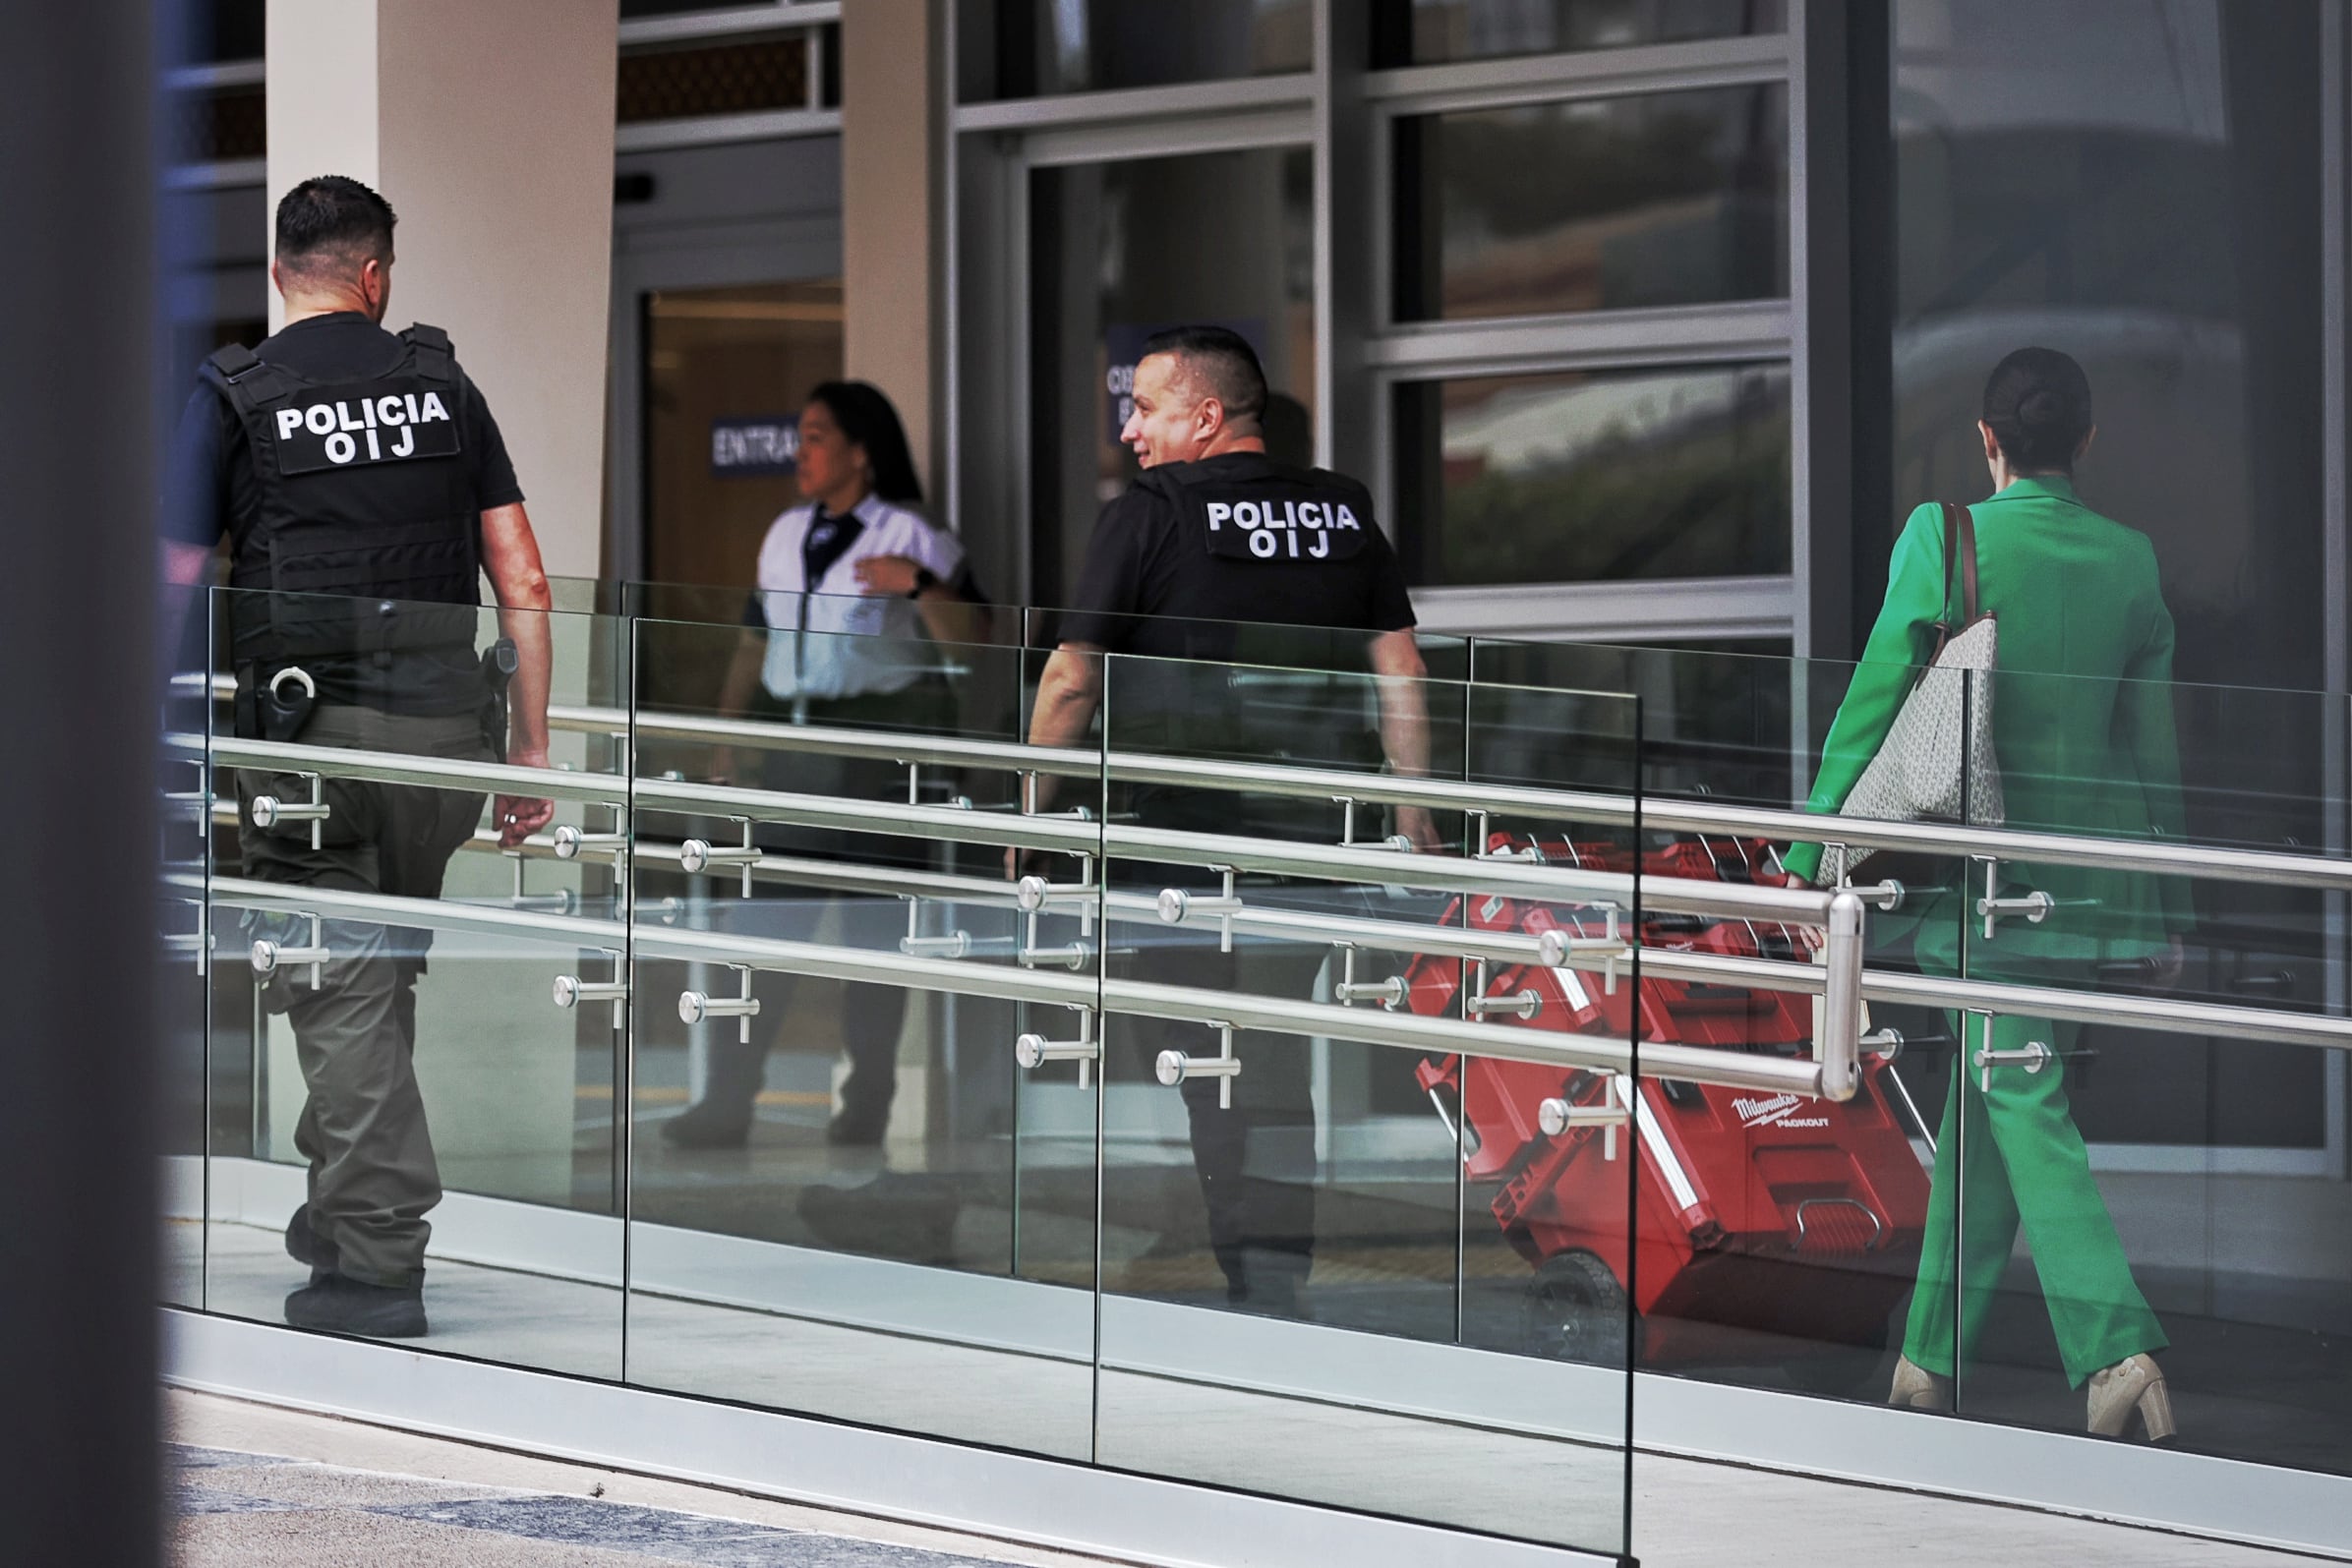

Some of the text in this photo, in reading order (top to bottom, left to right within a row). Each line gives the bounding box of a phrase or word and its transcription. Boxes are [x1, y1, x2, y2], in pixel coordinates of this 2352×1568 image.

[275, 392, 450, 440] POLICIA
[324, 425, 415, 464] OIJ
[1206, 500, 1361, 531] POLICIA
[1249, 529, 1329, 558] OIJ
[1731, 1092, 1799, 1122] Milwaukee
[1776, 1118, 1829, 1129] PACKOUT
